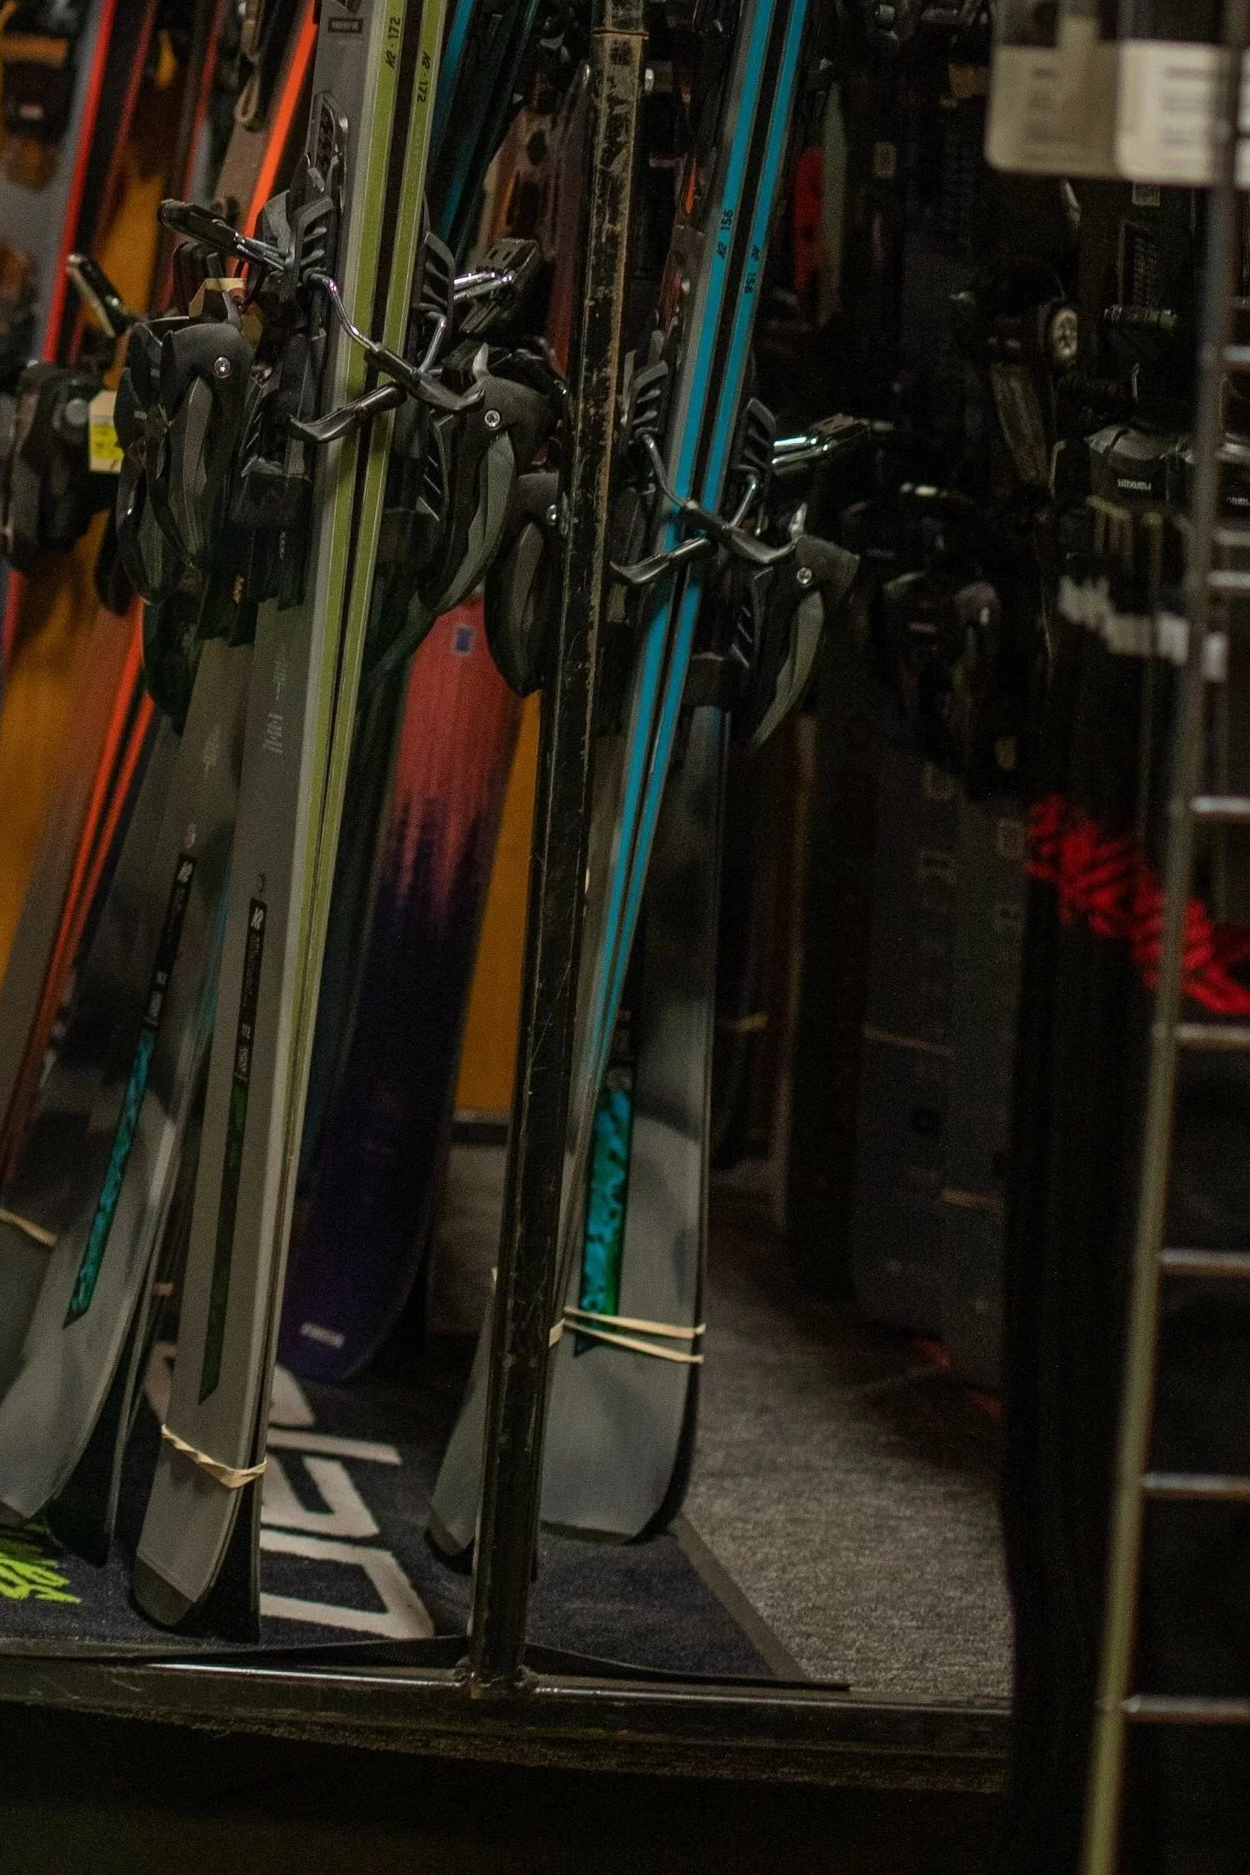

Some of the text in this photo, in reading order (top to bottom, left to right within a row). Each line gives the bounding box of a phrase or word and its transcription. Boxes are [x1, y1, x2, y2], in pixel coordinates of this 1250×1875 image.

[385, 17, 400, 69] K2 172
[417, 50, 432, 103] K2 172
